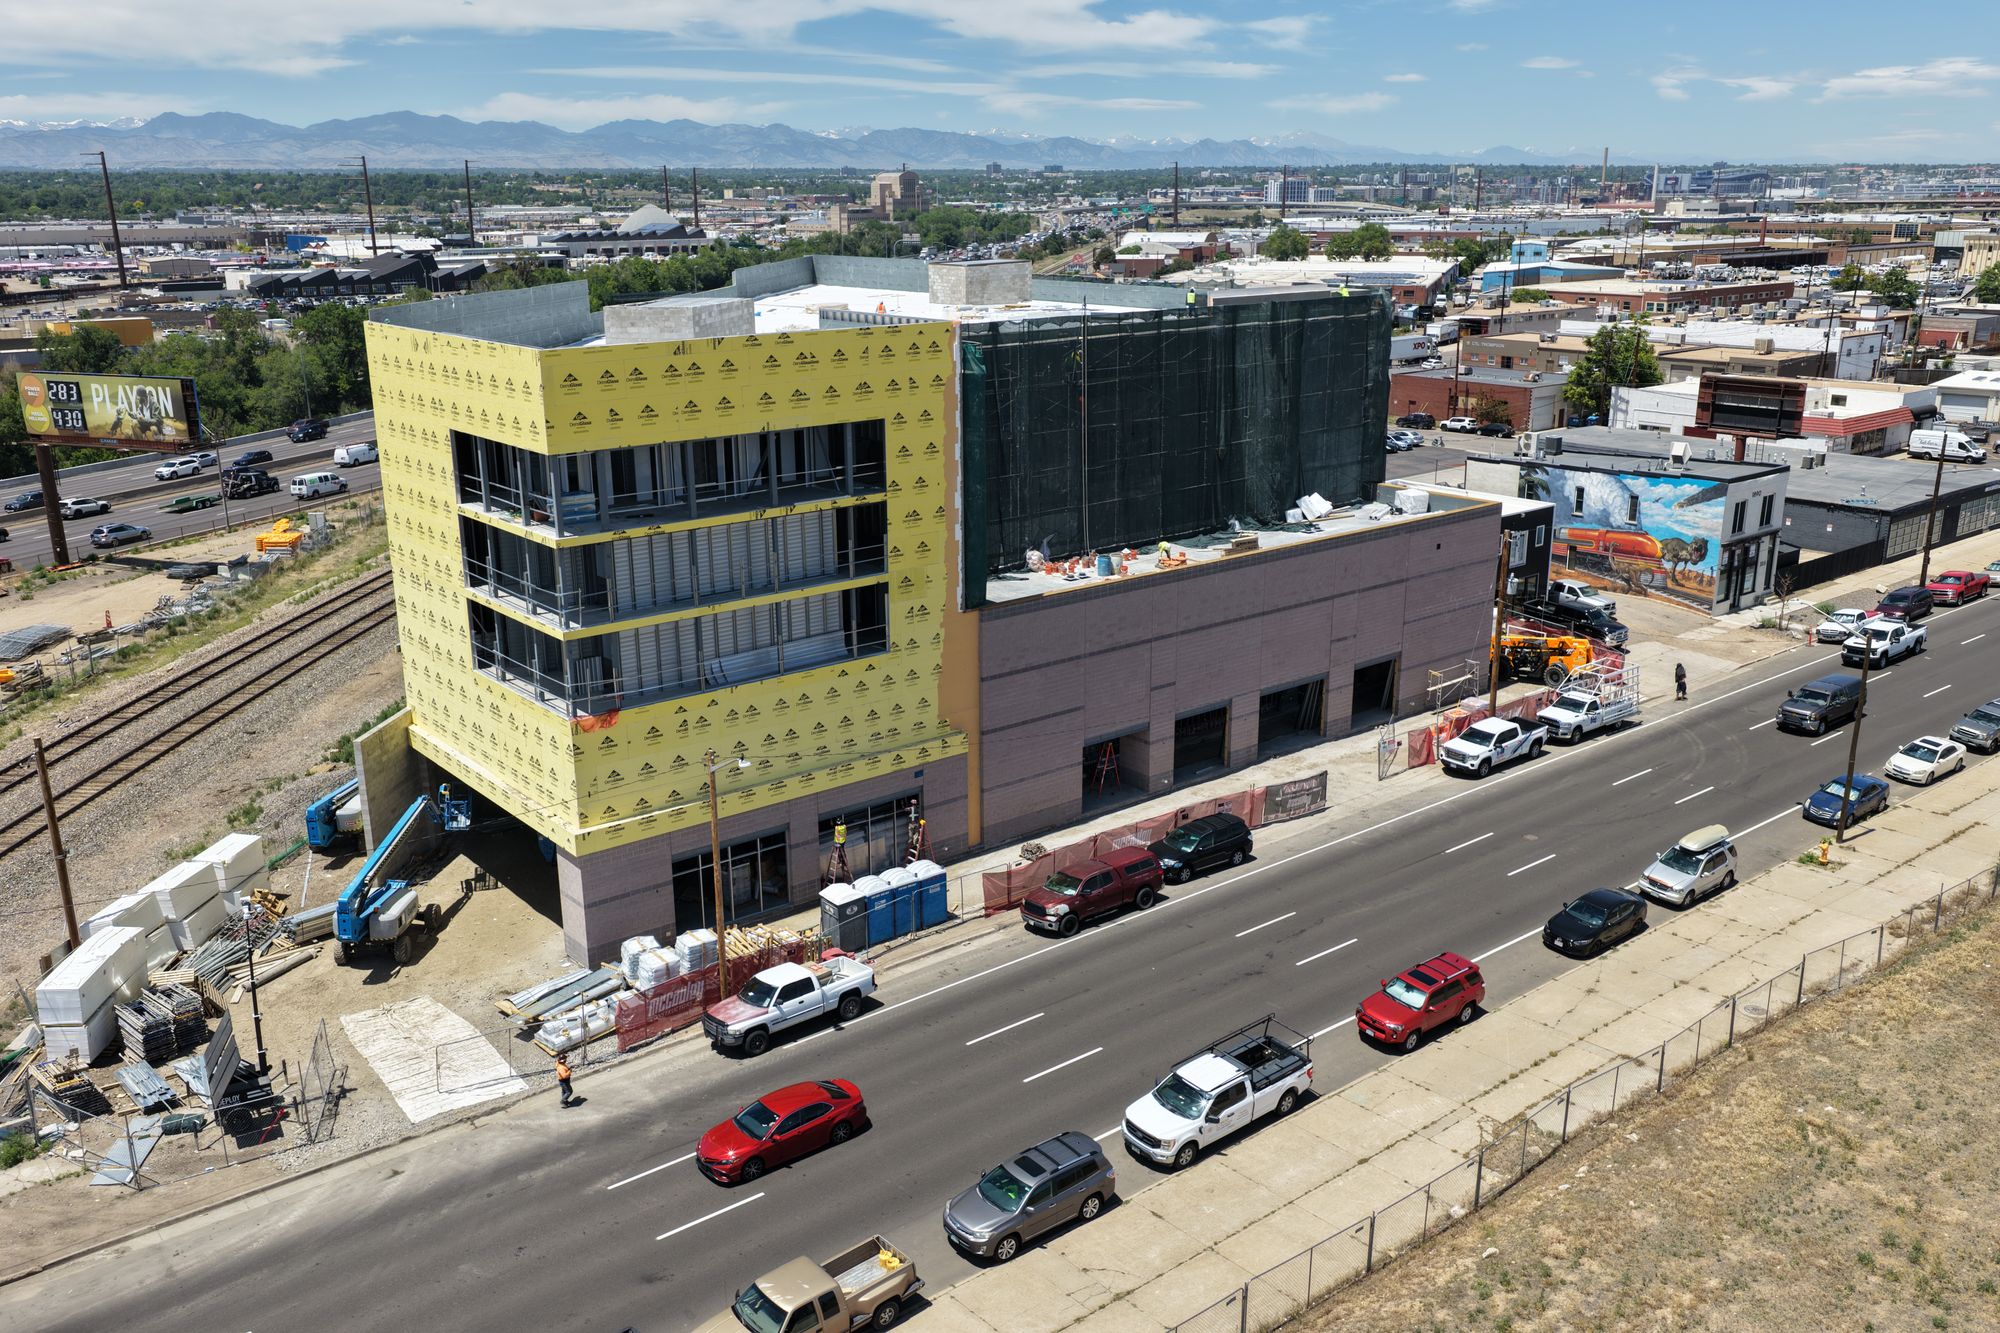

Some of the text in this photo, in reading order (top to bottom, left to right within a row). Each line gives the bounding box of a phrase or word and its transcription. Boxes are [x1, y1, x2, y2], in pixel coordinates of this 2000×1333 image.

[1413, 342, 1425, 350] XPO
[48, 383, 77, 400] 283
[91, 383, 139, 417] PLAY
[53, 410, 82, 427] 430
[219, 1094, 240, 1106] EPLOY
